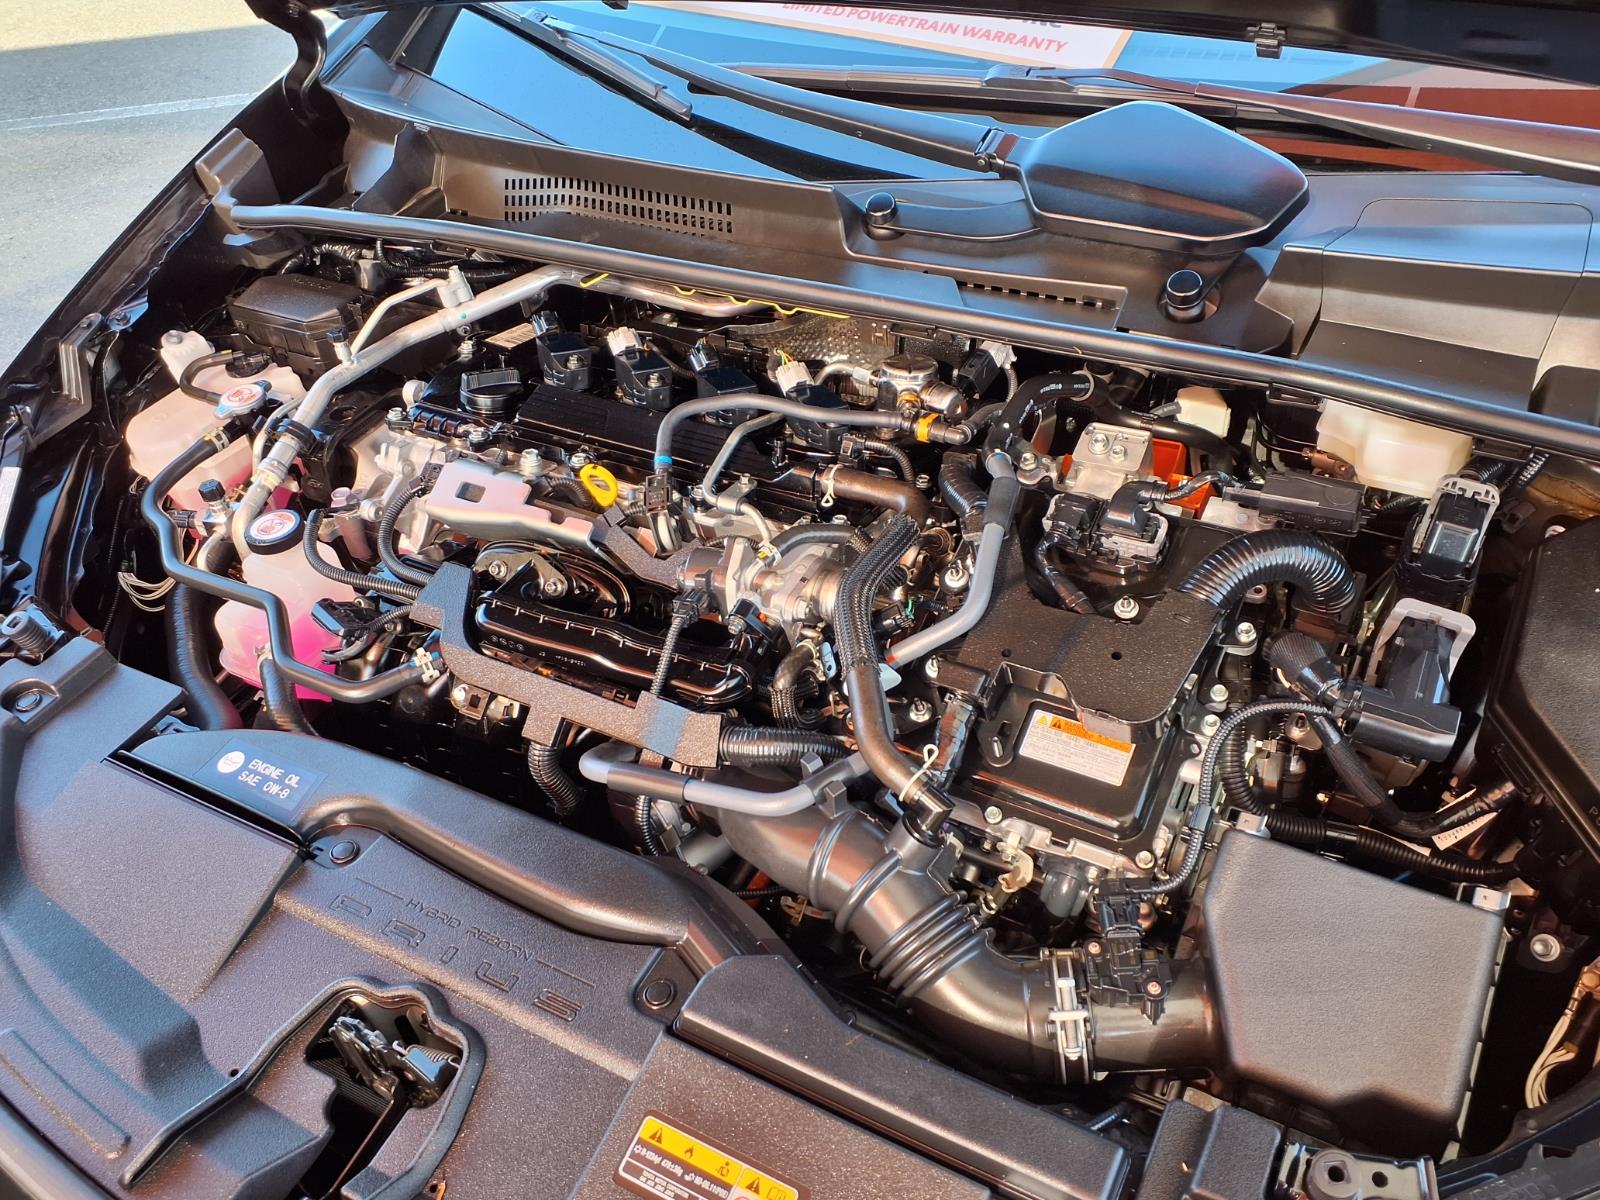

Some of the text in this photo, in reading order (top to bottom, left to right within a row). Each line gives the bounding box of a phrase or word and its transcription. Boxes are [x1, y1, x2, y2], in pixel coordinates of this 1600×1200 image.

[847, 8, 960, 34] POWERTRAIN
[962, 25, 1069, 52] WARRANTY
[238, 770, 262, 786] SAE
[248, 758, 285, 779] ENGINE
[406, 898, 533, 962] HYBRID REBORN
